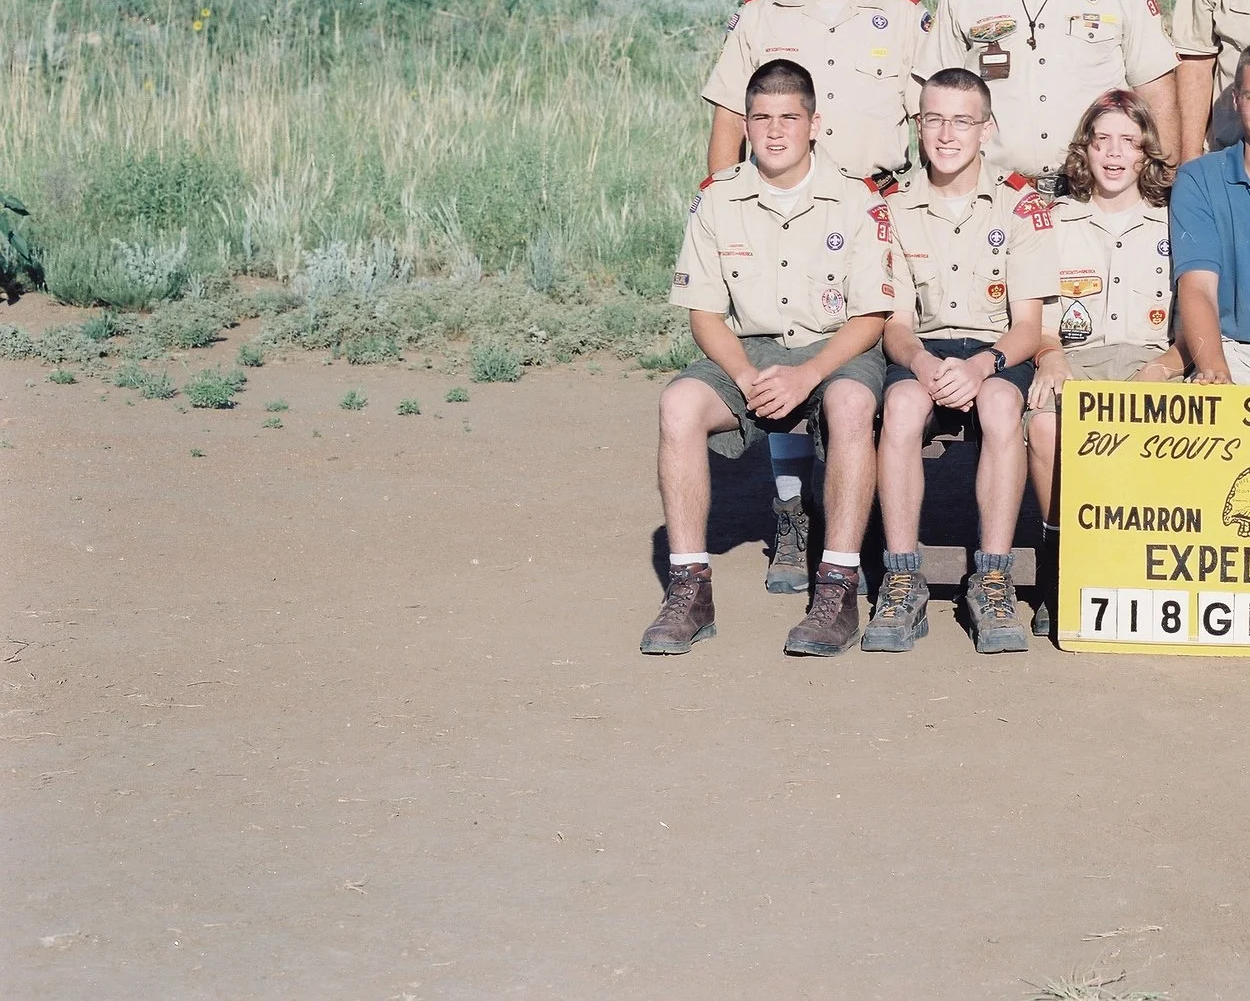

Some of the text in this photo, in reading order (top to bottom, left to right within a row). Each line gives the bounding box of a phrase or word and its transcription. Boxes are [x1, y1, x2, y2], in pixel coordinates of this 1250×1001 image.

[1034, 212, 1052, 228] 36
[1079, 391, 1222, 425] PHILMONT
[1077, 431, 1130, 457] BOY
[1139, 434, 1242, 461] SCOUTS
[1078, 503, 1202, 533] CIMARRON
